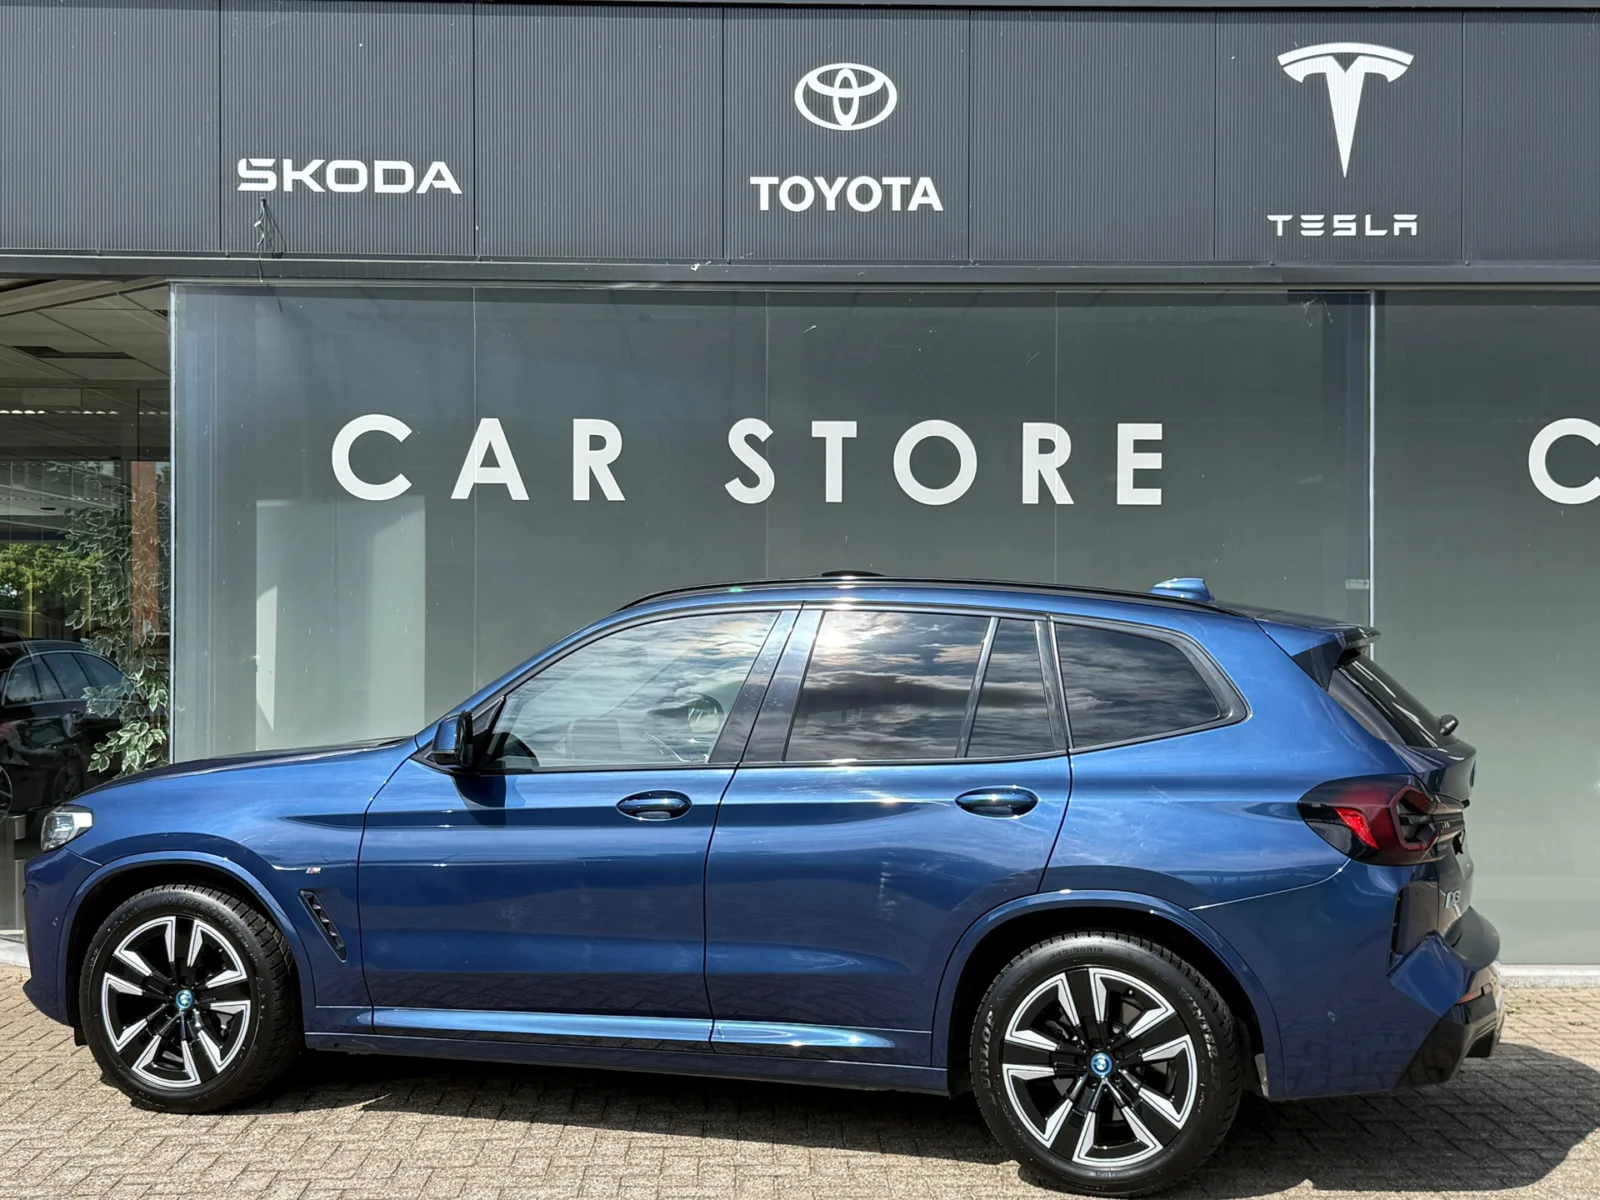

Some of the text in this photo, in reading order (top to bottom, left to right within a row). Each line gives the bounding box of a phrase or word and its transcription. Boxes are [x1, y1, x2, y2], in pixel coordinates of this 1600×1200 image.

[749, 175, 944, 213] TOYOTA
[1267, 214, 1418, 237] TESLA
[331, 413, 1163, 506] CAR STORE
